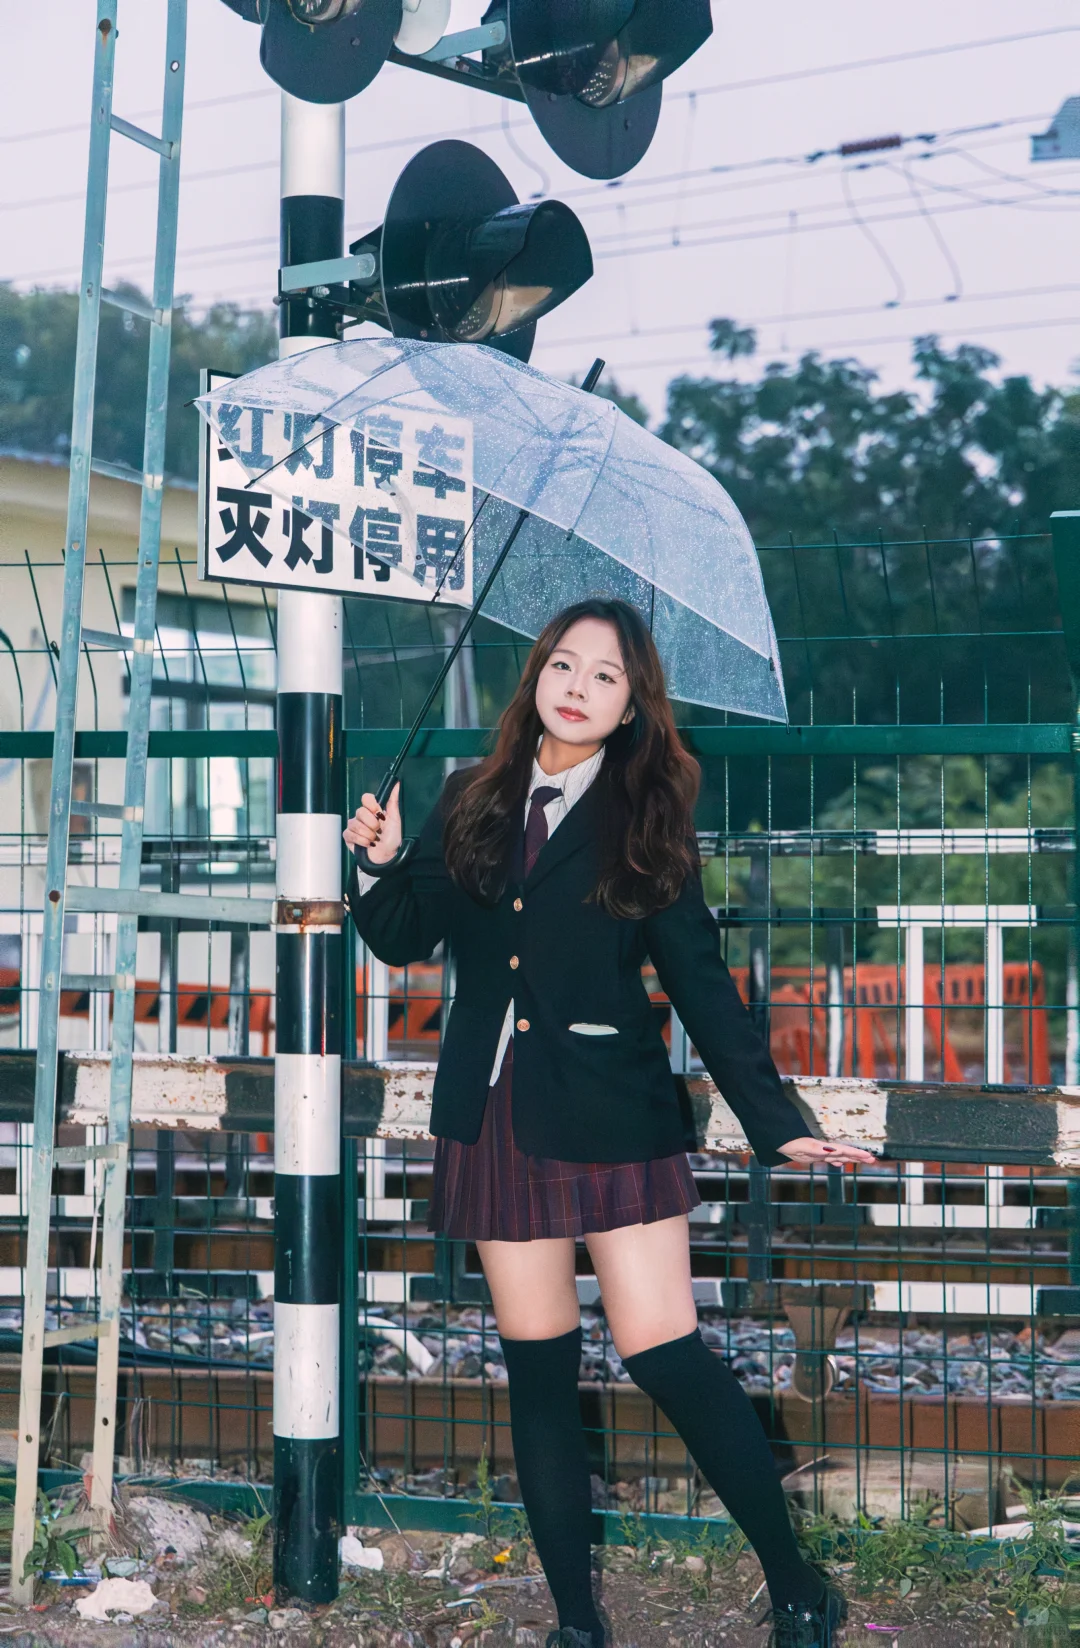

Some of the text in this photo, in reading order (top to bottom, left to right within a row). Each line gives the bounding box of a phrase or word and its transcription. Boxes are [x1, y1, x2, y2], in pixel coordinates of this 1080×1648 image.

[216, 400, 466, 499] 红灯停车
[214, 486, 466, 591] 灭灯停用
